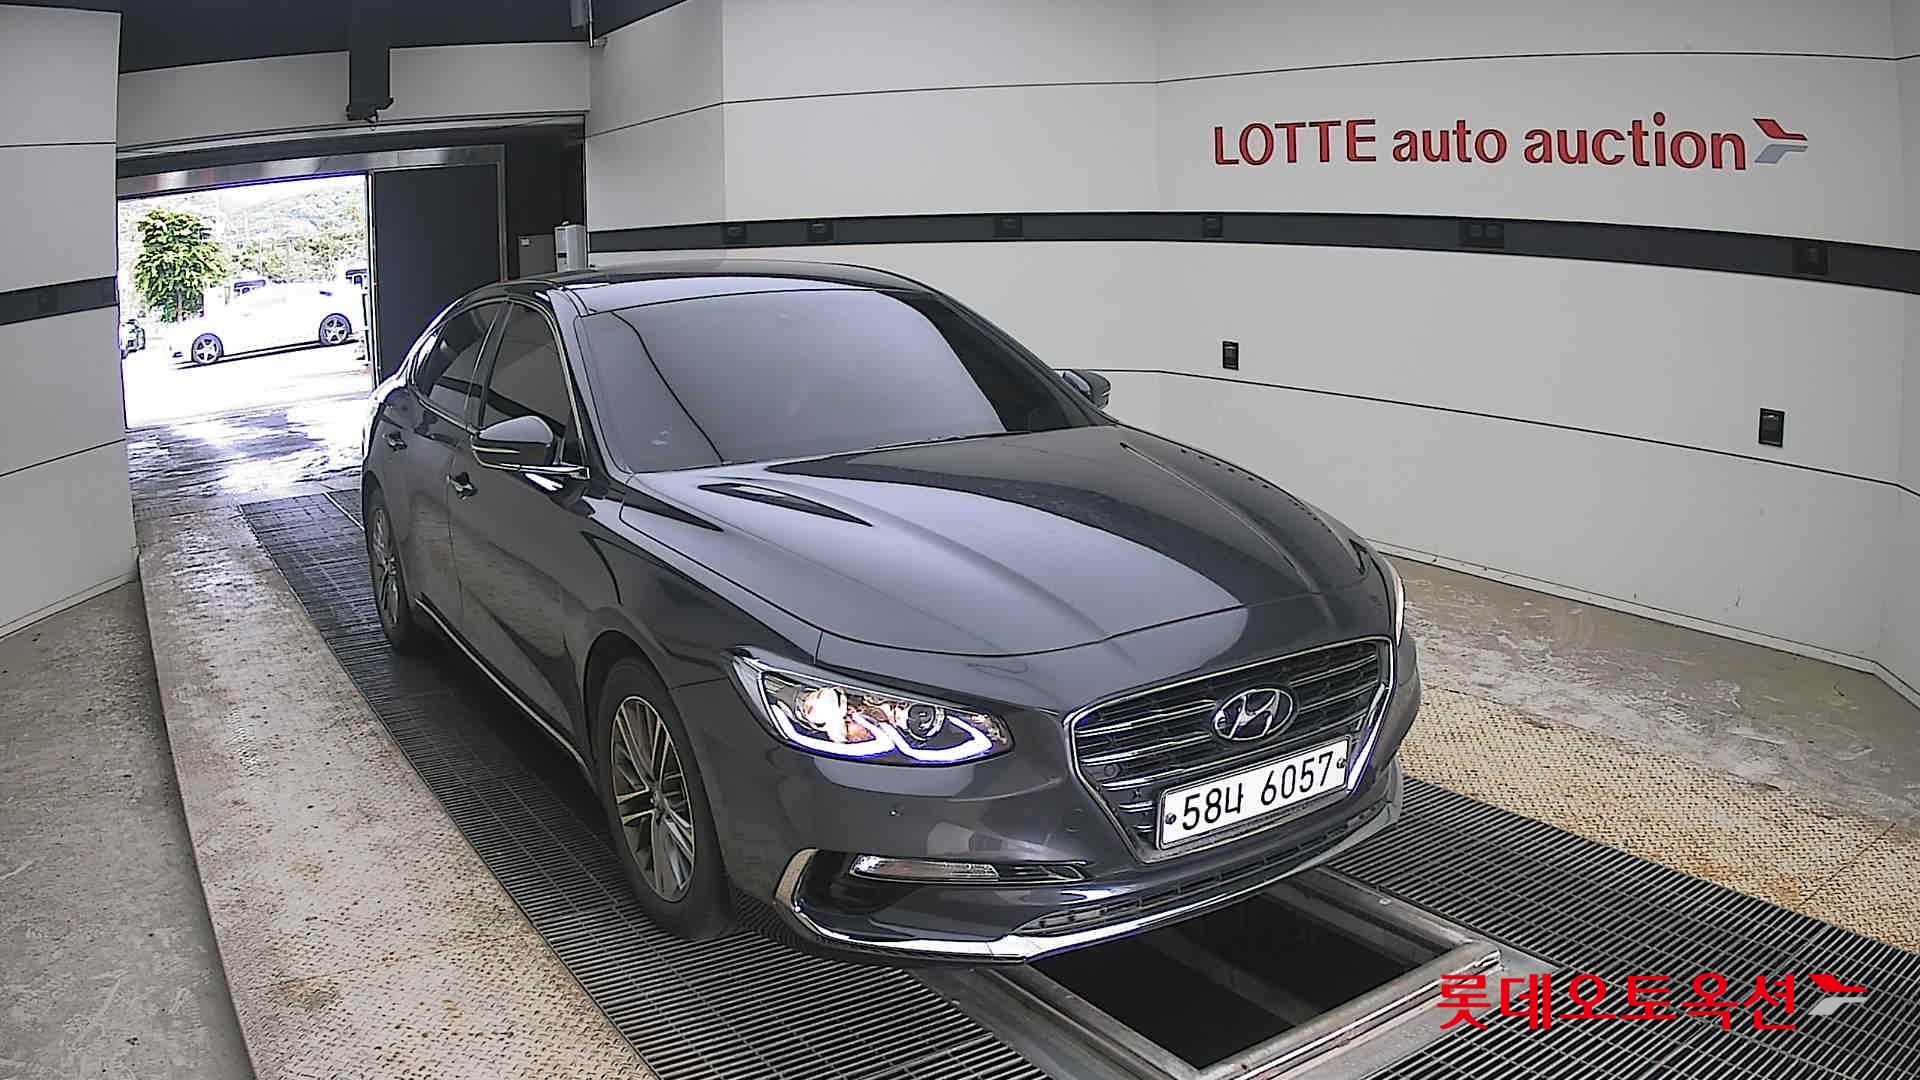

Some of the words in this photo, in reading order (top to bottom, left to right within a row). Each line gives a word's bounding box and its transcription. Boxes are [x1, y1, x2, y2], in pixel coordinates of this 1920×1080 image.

[1214, 118, 1377, 165] LOTTE
[1392, 119, 1508, 164] auto
[1523, 112, 1747, 171] auction
[1182, 782, 1244, 831] 58나
[1260, 751, 1334, 806] 6057
